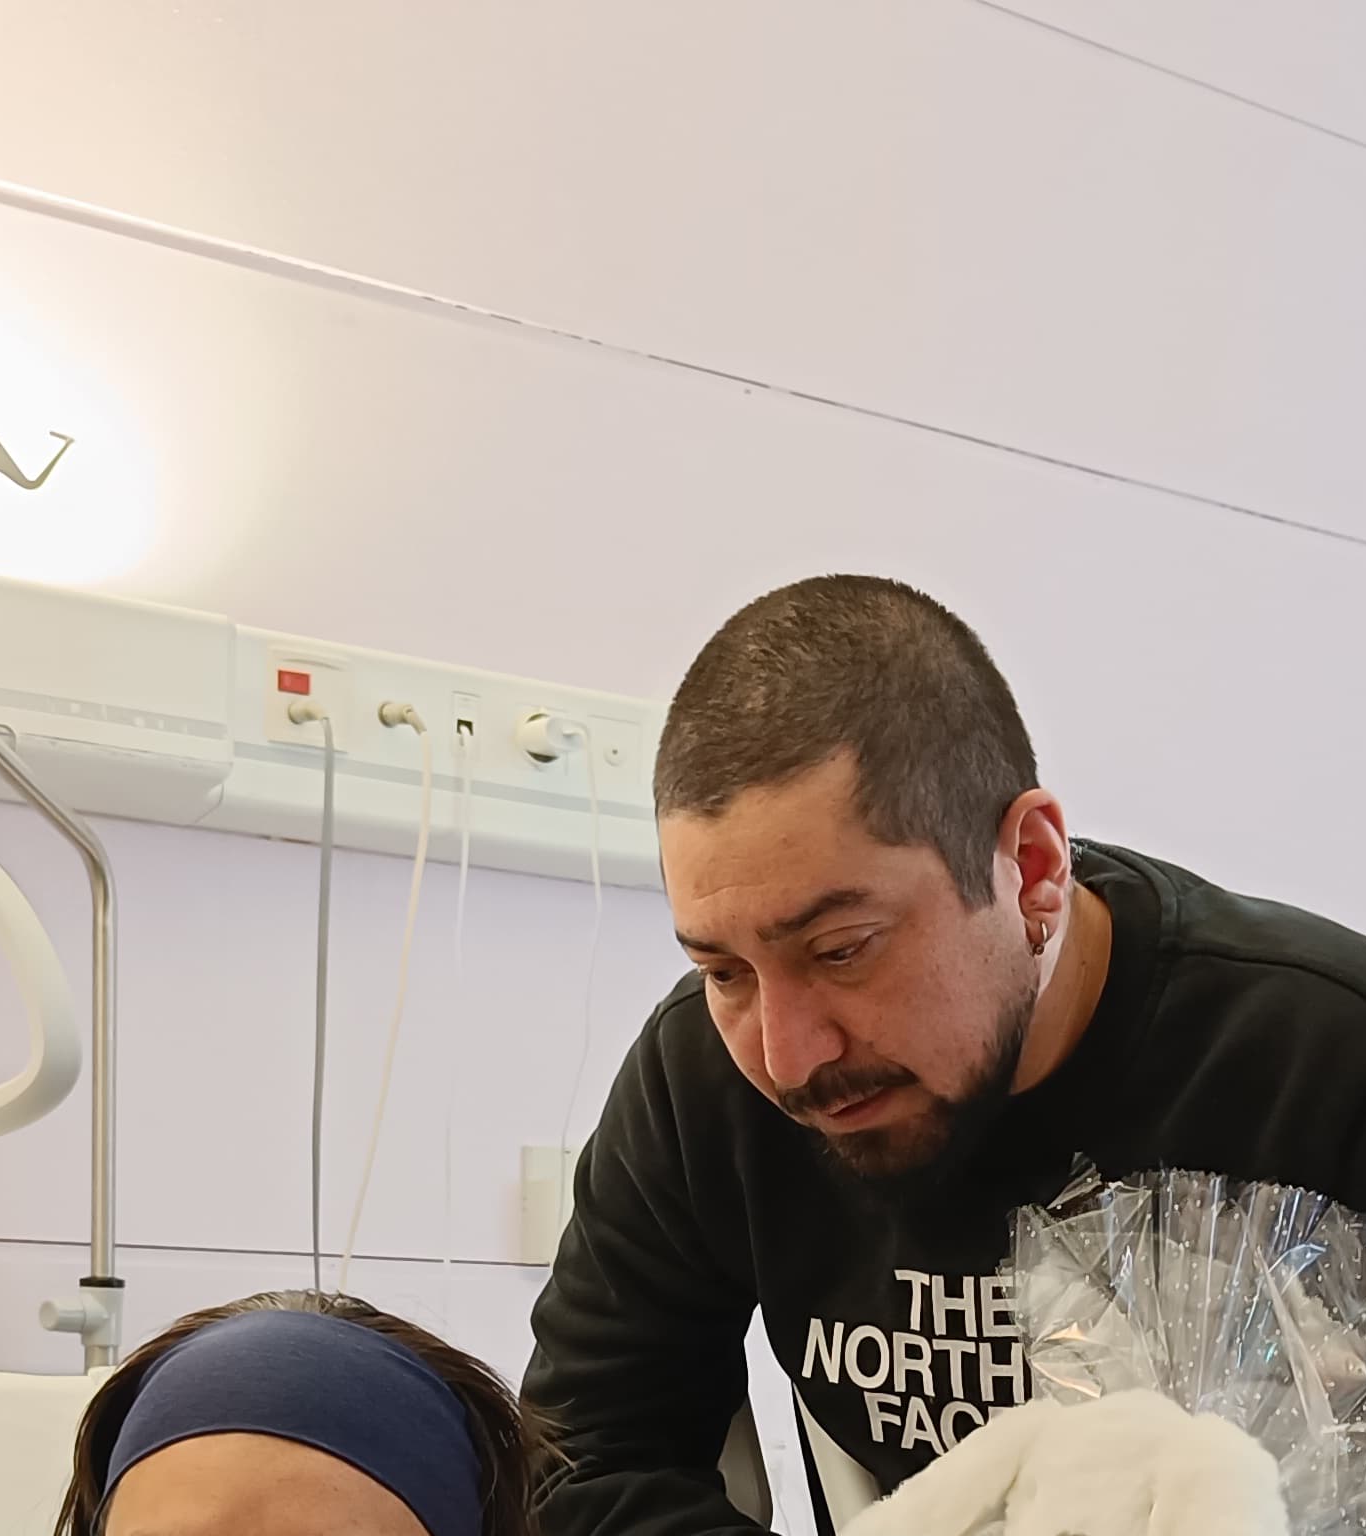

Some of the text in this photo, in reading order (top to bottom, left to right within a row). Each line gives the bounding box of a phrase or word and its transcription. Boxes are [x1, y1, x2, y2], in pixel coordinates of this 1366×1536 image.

[894, 1269, 1022, 1337] THE
[802, 1317, 1025, 1404] NORTH
[864, 1391, 1014, 1456] FAC
